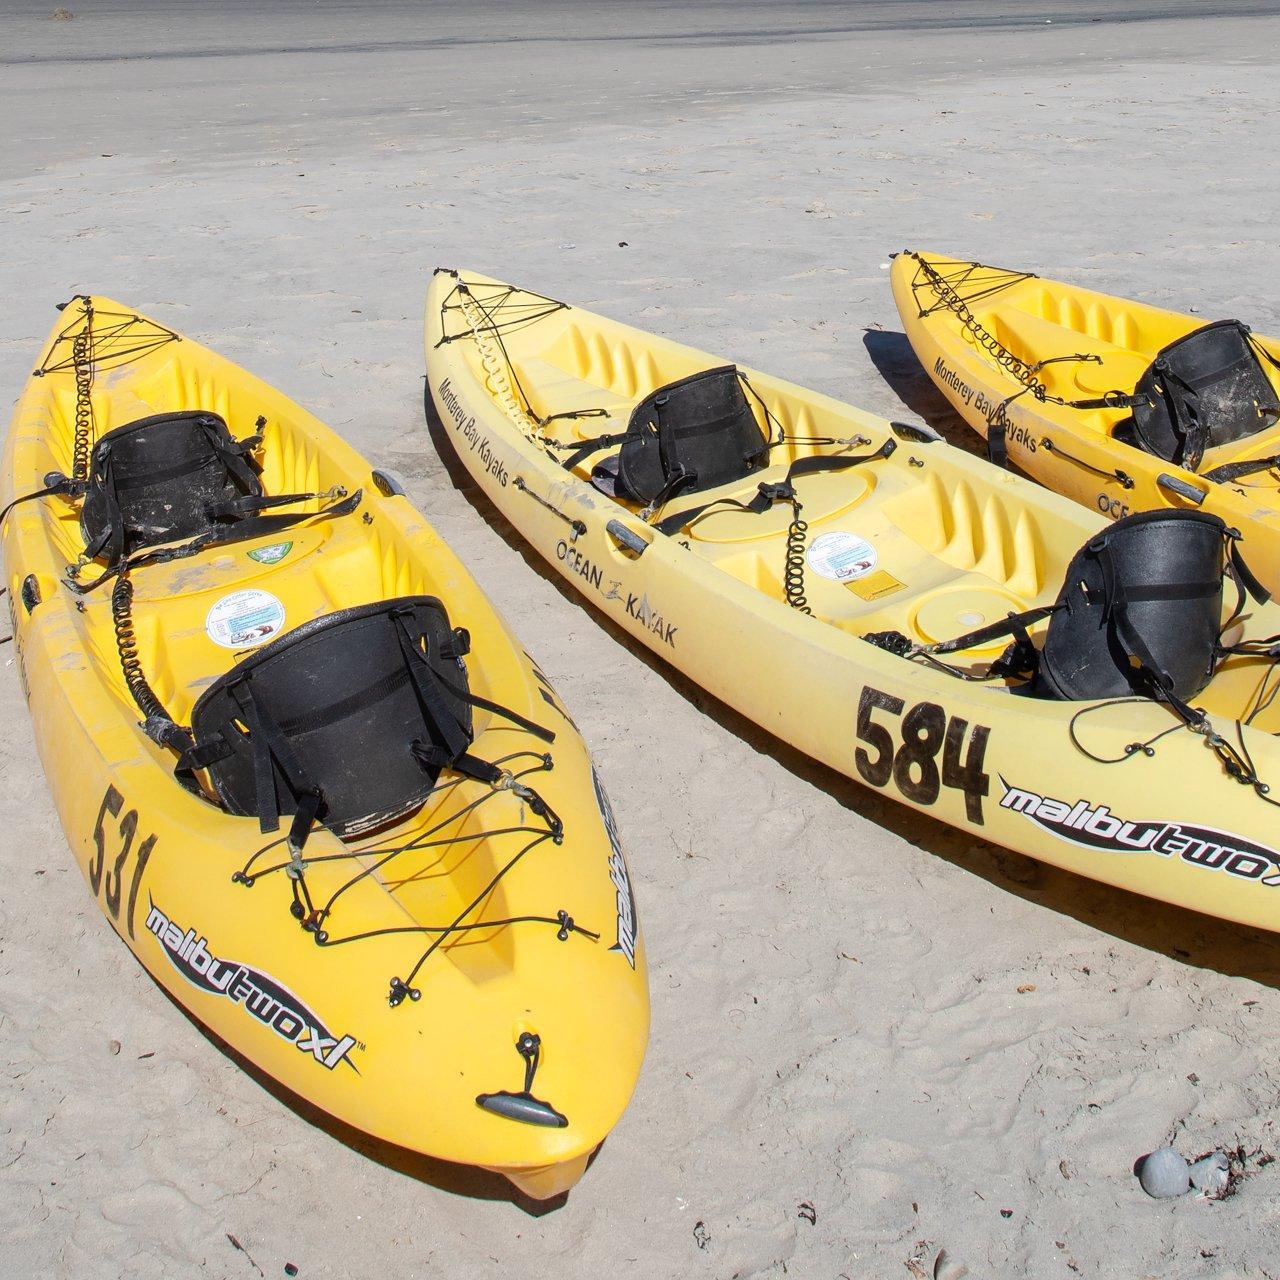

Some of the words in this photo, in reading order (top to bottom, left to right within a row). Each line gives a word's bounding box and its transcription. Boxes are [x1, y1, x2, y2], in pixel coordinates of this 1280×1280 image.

[439, 378, 467, 431] Monterey
[463, 417, 481, 451] Bay
[477, 437, 509, 487] Kayaks
[933, 357, 975, 406] Monterey
[974, 391, 996, 424] Bay
[855, 685, 991, 826] 584
[89, 783, 158, 941] 531
